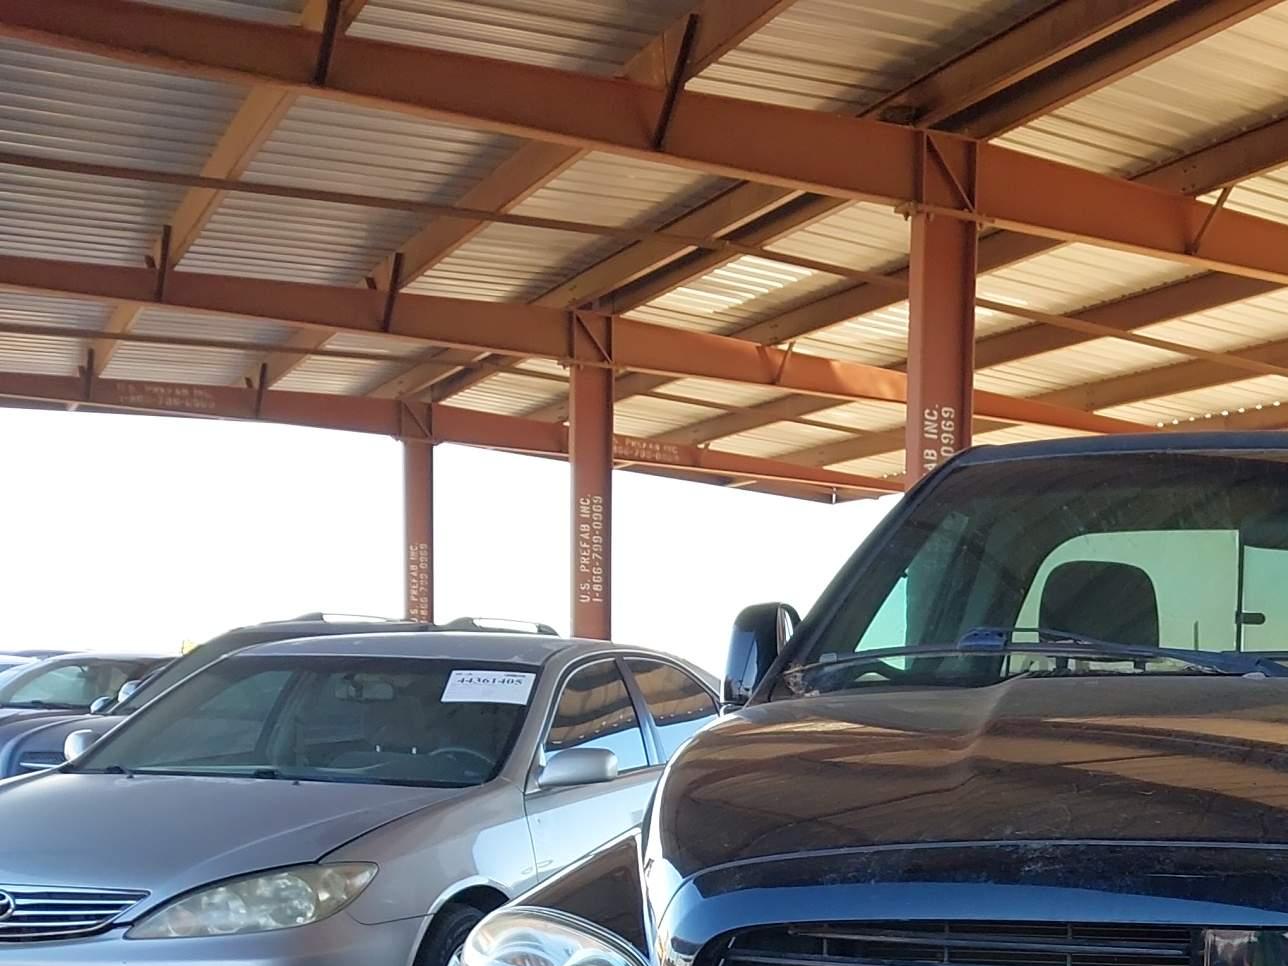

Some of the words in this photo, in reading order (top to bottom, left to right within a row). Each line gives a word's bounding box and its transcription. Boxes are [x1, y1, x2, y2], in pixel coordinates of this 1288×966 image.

[924, 404, 939, 440] INC.
[580, 494, 591, 519] INC.
[580, 523, 591, 573] PREFAB
[580, 579, 591, 603] U.S.
